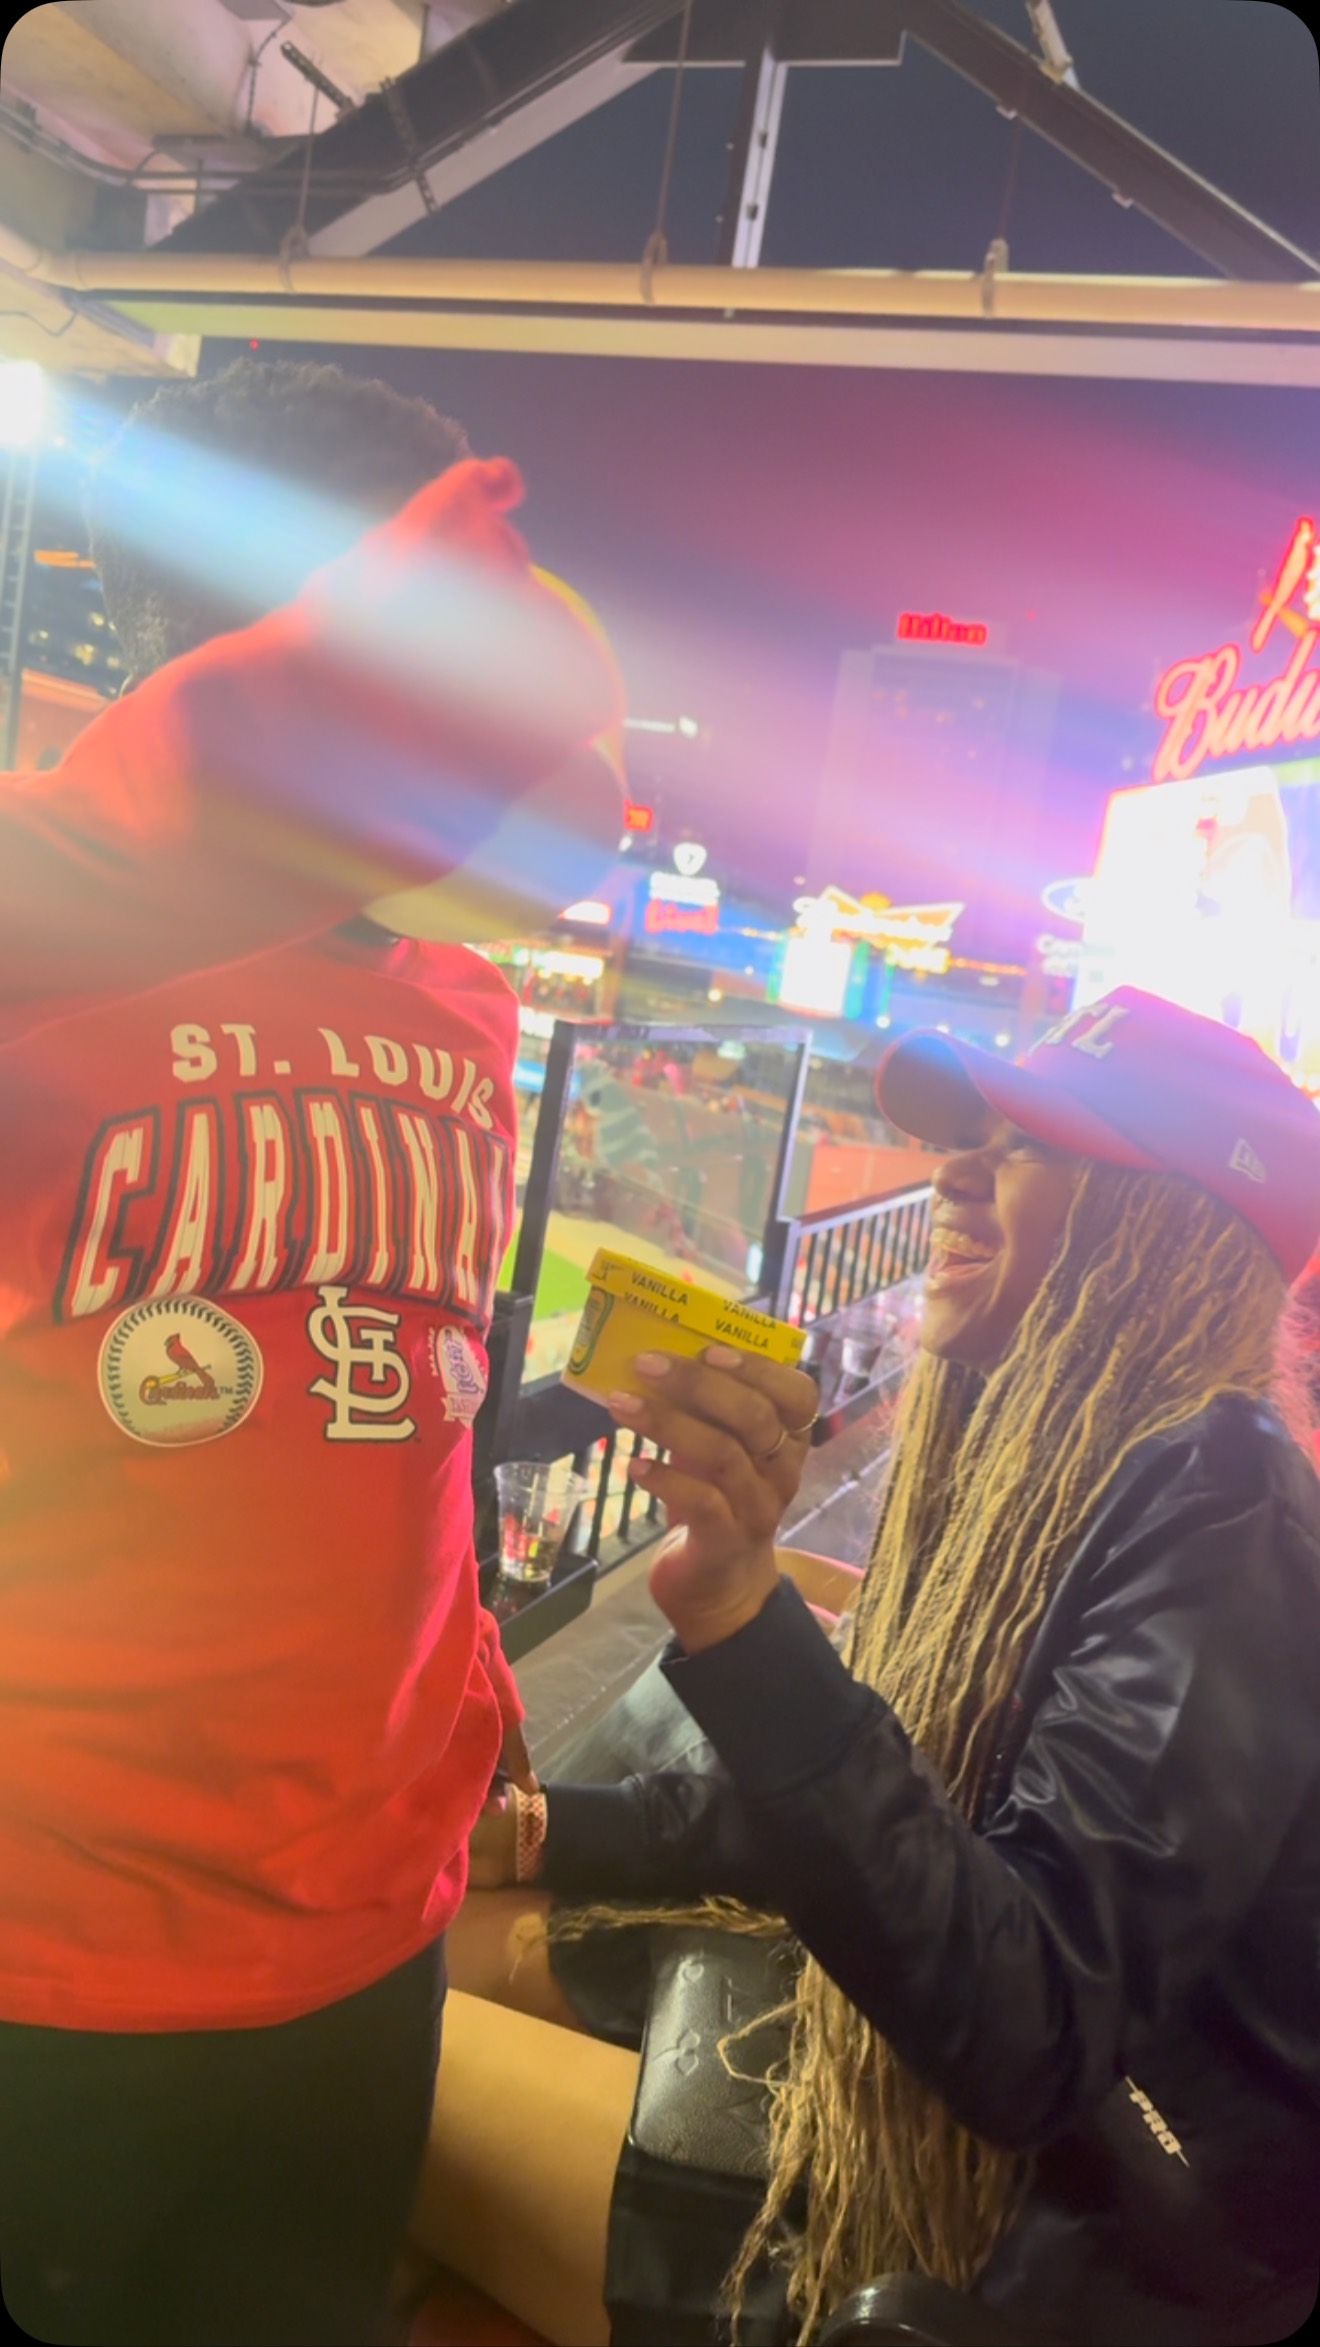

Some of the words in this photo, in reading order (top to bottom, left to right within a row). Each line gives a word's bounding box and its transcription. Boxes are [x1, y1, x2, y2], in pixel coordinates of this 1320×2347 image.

[169, 1023, 291, 1083] ST.
[318, 1027, 494, 1129] LOUIS
[631, 1271, 689, 1306] VANILLA
[624, 1291, 681, 1324] VANILLA
[723, 1299, 777, 1330] VANILLA
[715, 1318, 770, 1350] VANILLA
